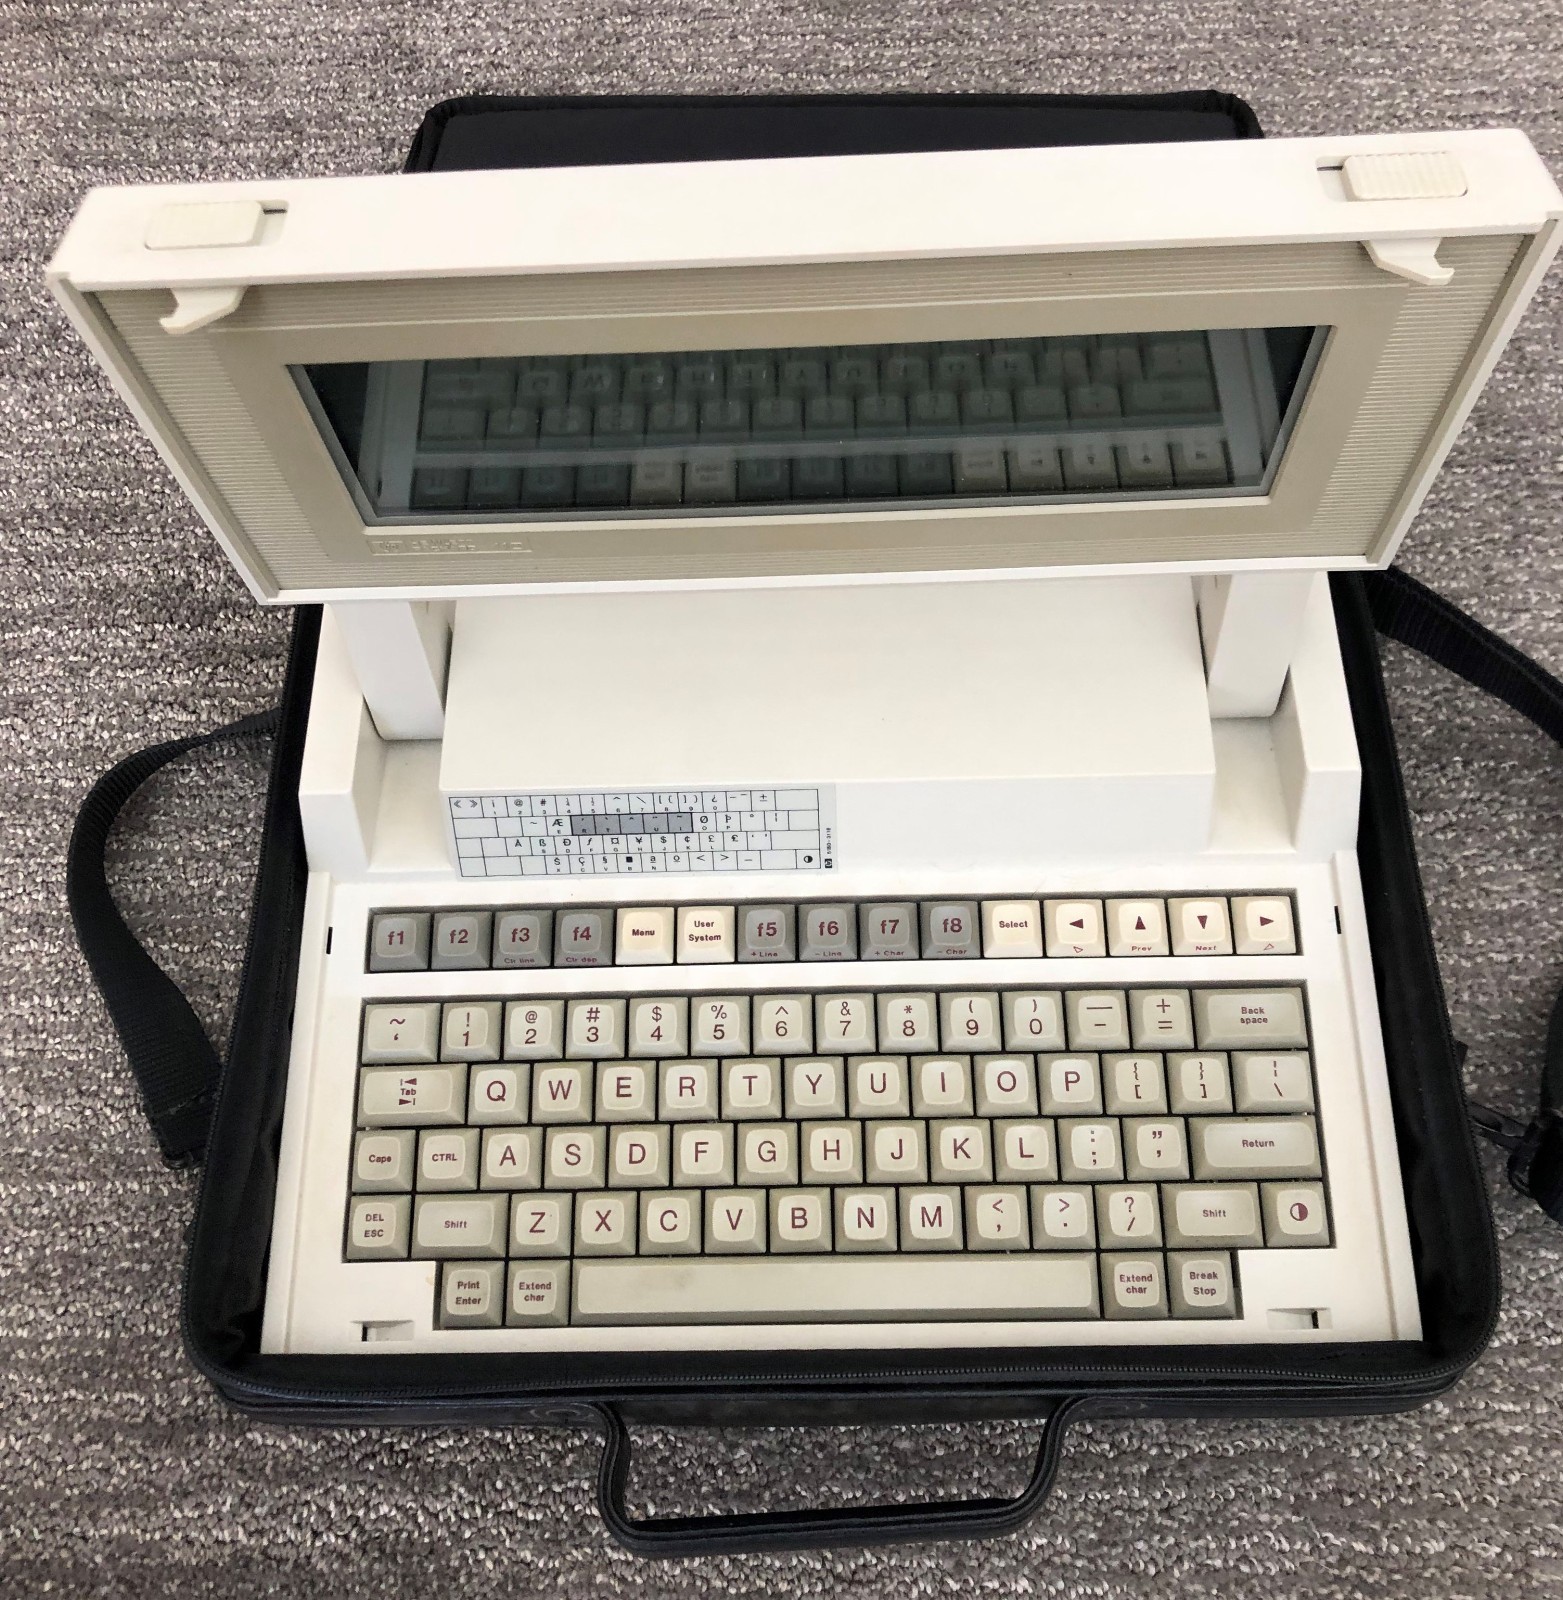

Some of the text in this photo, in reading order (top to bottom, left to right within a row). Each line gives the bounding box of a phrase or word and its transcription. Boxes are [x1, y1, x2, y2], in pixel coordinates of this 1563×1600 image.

[757, 922, 777, 937] f5
[819, 921, 839, 936] f6
[881, 919, 899, 934] f7
[943, 918, 962, 933] f8
[388, 931, 404, 945] f1
[450, 929, 468, 943] f2
[512, 928, 529, 942] f3
[573, 927, 591, 941] f4
[689, 934, 721, 942] System
[652, 1006, 662, 1022] $
[711, 1005, 727, 1019] %
[841, 1002, 851, 1016] &
[1156, 999, 1170, 1013] +
[586, 1007, 600, 1022] #
[713, 1024, 725, 1040] 5
[776, 1021, 787, 1036] 6
[840, 1021, 851, 1036] 7
[903, 1020, 915, 1036] 8
[966, 1019, 978, 1035] 9
[1030, 1019, 1042, 1035] 0
[1158, 1021, 1172, 1029] =
[463, 1031, 469, 1046] 1
[525, 1029, 536, 1044] 2
[587, 1027, 598, 1042] 3
[651, 1026, 662, 1041] 4
[616, 1077, 632, 1097] E
[679, 1077, 695, 1097] R
[743, 1076, 758, 1096] T
[806, 1074, 822, 1094] Y
[871, 1073, 886, 1093] U
[997, 1071, 1016, 1092] O
[1065, 1071, 1080, 1091] P
[487, 1081, 506, 1101] Q
[549, 1080, 572, 1100] W
[565, 1144, 581, 1166] S
[629, 1144, 646, 1164] D
[695, 1142, 709, 1162] F
[758, 1141, 776, 1162] G
[824, 1139, 840, 1160] H
[891, 1139, 903, 1160] J
[954, 1138, 971, 1159] K
[1019, 1137, 1034, 1158] L
[432, 1153, 457, 1162] CTRL
[499, 1146, 516, 1166] A
[1125, 1197, 1134, 1213] ?
[1203, 1209, 1226, 1217] Shift
[529, 1212, 545, 1233] Z
[595, 1210, 611, 1231] X
[660, 1210, 677, 1231] C
[726, 1209, 743, 1230] V
[792, 1207, 808, 1229] B
[858, 1207, 874, 1228] N
[921, 1206, 942, 1227] M
[364, 1229, 384, 1237] ESC
[1120, 1274, 1152, 1282] Extend
[1190, 1272, 1218, 1280] Break
[458, 1281, 480, 1289] Print
[519, 1282, 551, 1290] Extend
[1126, 1286, 1147, 1294] char
[1194, 1287, 1216, 1296] Stop
[456, 1297, 481, 1305] Enter
